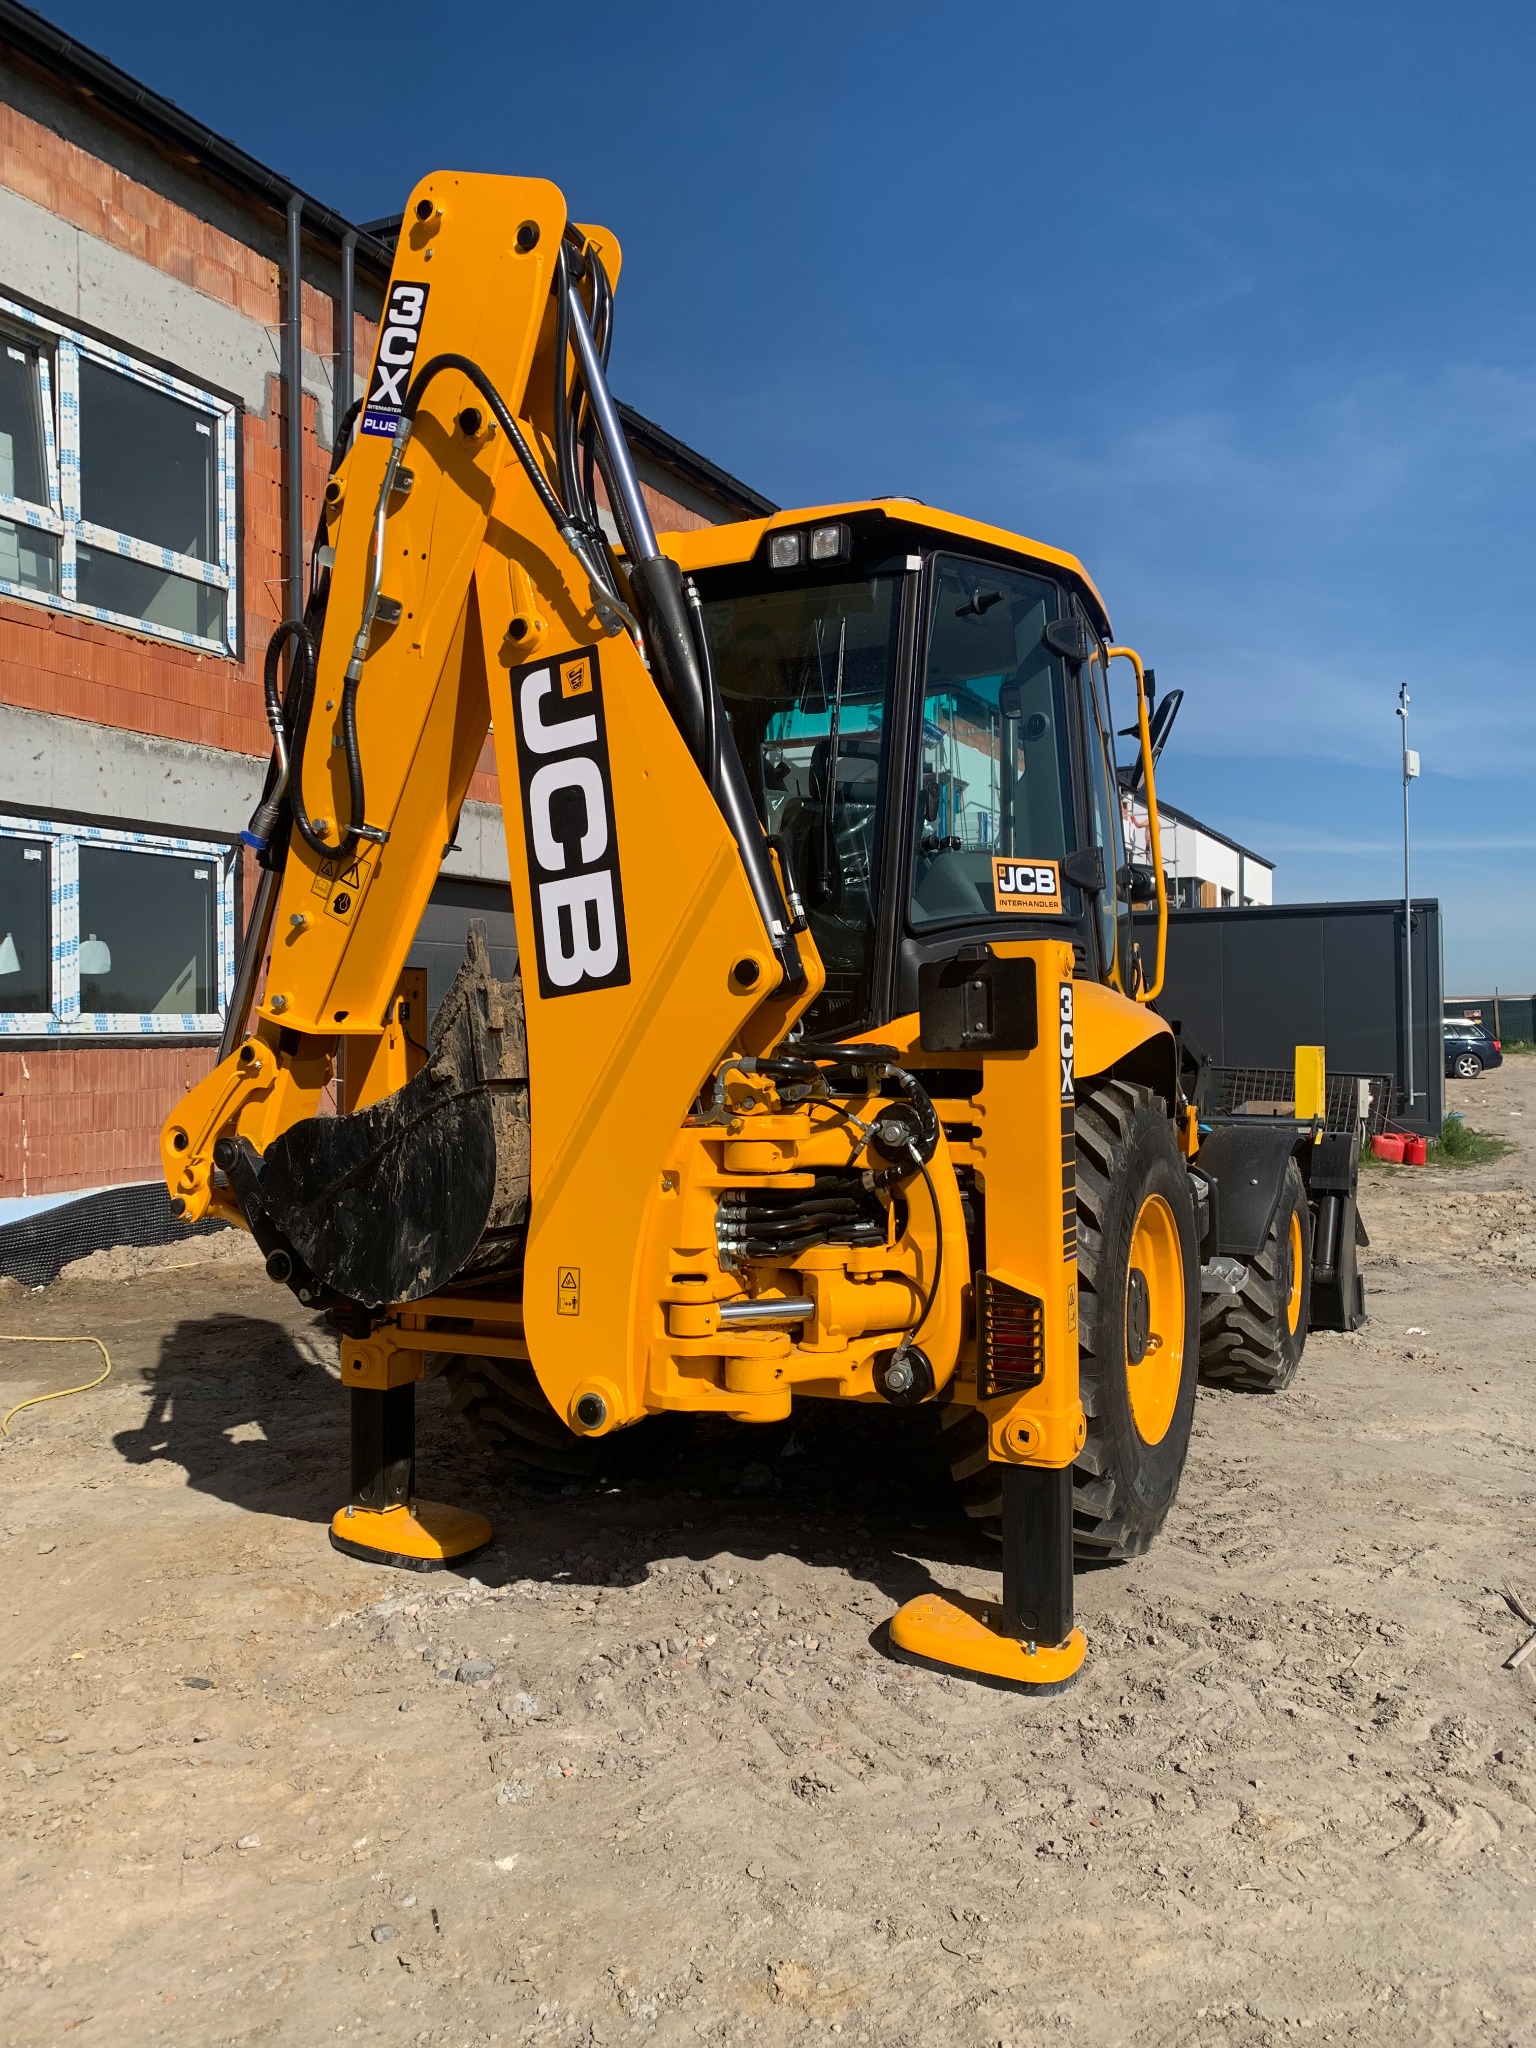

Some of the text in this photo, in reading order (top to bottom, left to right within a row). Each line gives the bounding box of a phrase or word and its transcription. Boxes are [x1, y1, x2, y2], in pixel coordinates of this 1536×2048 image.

[369, 286, 424, 405] 3CX
[367, 404, 402, 413] SITEMASTER
[364, 418, 397, 432] PLUS
[520, 667, 618, 987] JCB
[999, 866, 1056, 894] JCB
[999, 900, 1058, 908] INTERHANDLER
[1060, 986, 1074, 1092] 3CX
